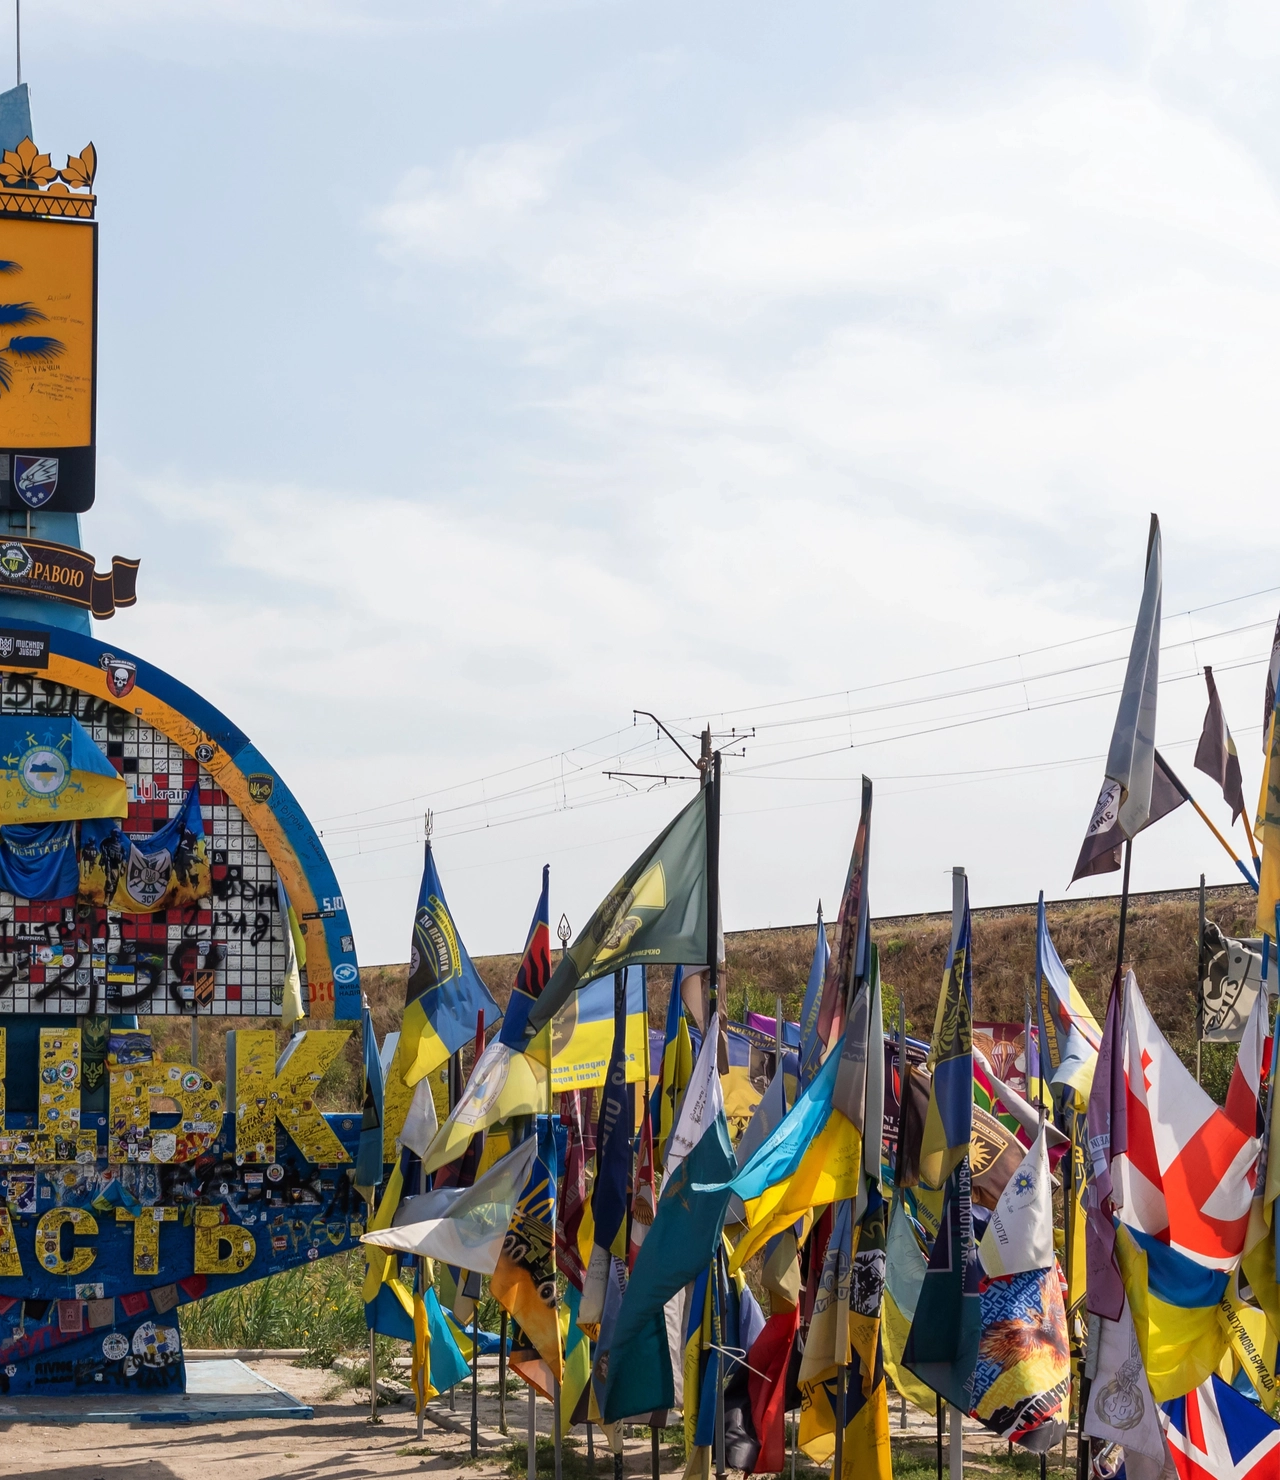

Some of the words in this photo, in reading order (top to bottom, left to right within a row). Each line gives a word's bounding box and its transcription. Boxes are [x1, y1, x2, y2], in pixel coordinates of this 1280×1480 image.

[141, 894, 156, 904] ЗСУ
[420, 914, 430, 926] ДО
[428, 926, 450, 973] ПЕРЕМОГИ
[959, 1196, 971, 1238] ПІХОТА
[1249, 1353, 1274, 1392] БРИГАДА
